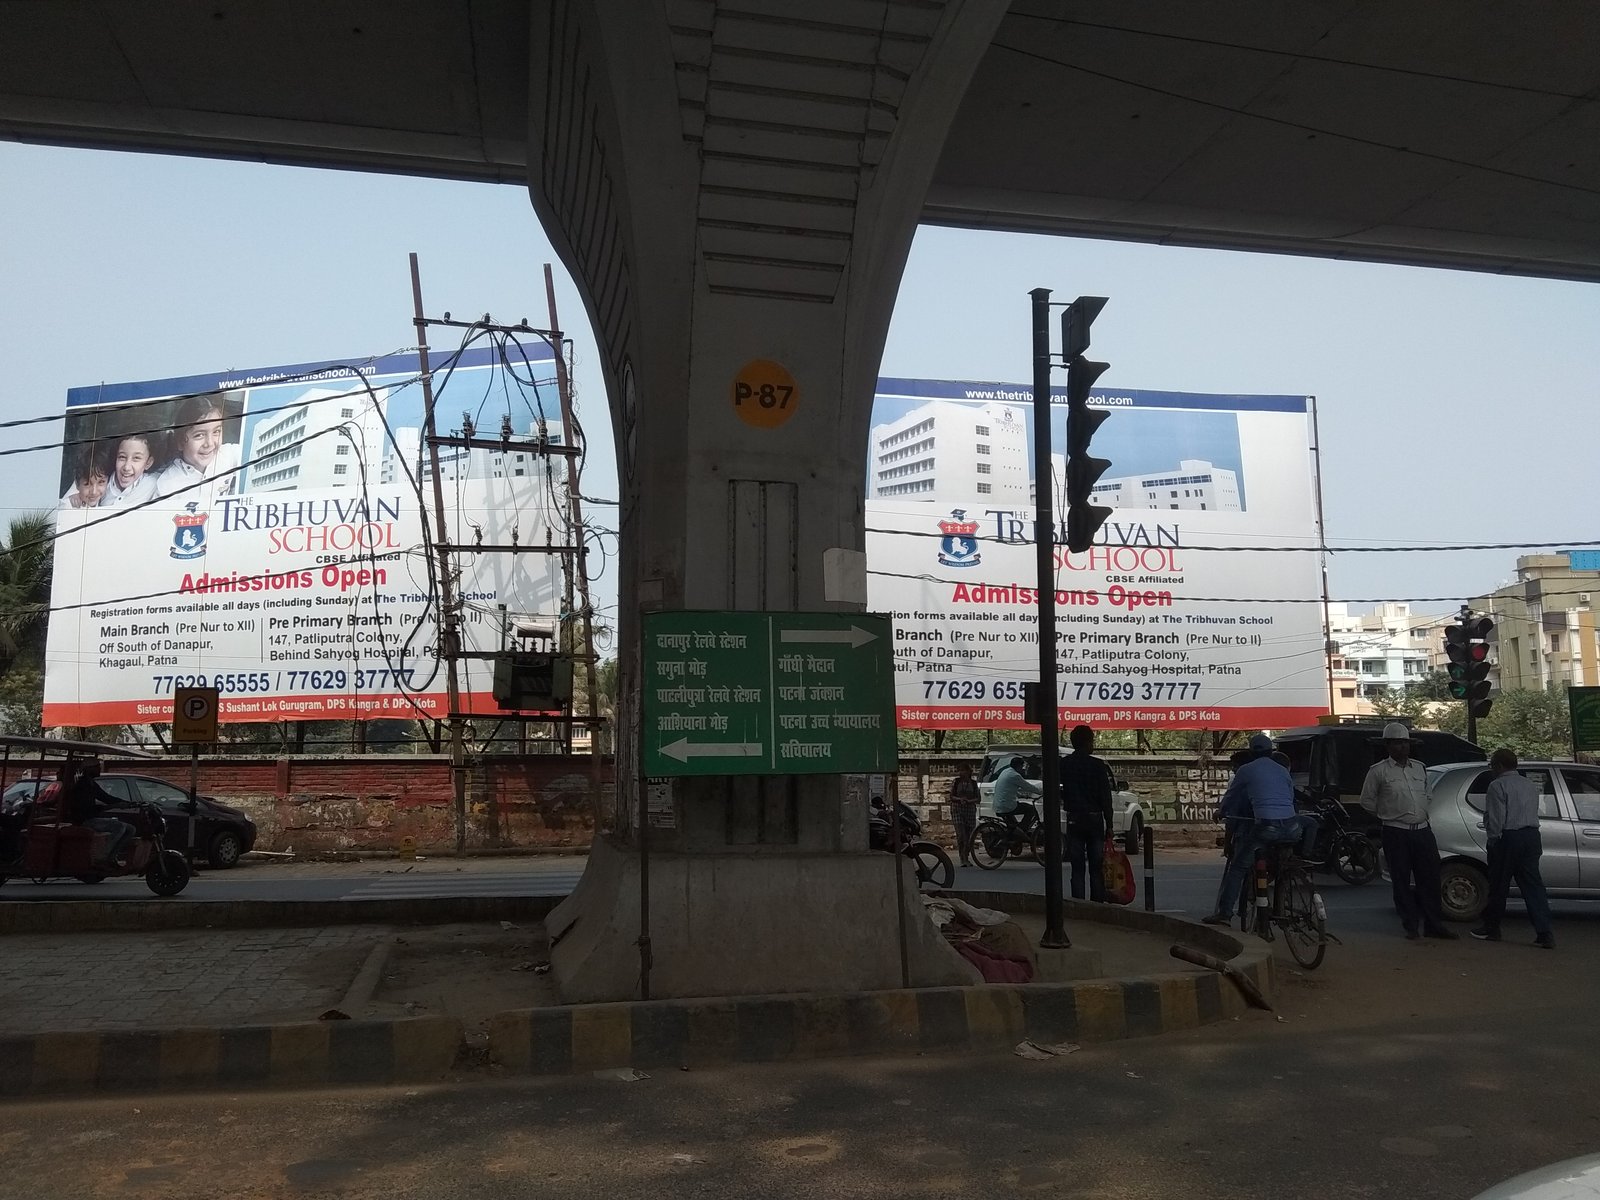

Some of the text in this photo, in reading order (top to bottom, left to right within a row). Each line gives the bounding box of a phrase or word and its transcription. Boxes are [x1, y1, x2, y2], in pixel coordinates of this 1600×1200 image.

[218, 365, 376, 389] wwwthetribhanschool.com
[736, 382, 794, 409] P-87
[965, 389, 1133, 406] www.thetribvanool.com
[214, 496, 401, 533] TRIBHUVAN
[268, 522, 401, 554] SCHOOL
[316, 554, 346, 564] CBSE
[1053, 544, 1184, 572] SCHOOL
[178, 564, 387, 595] Admissions Open
[1106, 575, 1184, 584] CBSE Affiliated
[90, 590, 497, 620] Registration forms available all days (including Sunday) at The Tribhu School
[952, 582, 1173, 611] Admisons Open
[269, 618, 290, 630] Pre
[292, 615, 342, 630] Primary
[346, 613, 392, 627] Branch
[470, 612, 482, 625] II)
[914, 611, 946, 620] forms
[949, 611, 1000, 622] available
[1002, 612, 1016, 622] all
[1018, 612, 1038, 624] day
[1054, 614, 1100, 625] ncluding
[1102, 614, 1146, 626] Sunday)
[1148, 615, 1160, 624] at
[1162, 615, 1182, 624] The
[1185, 615, 1236, 624] Tribhuvan
[1238, 616, 1274, 625] School
[100, 619, 256, 638] Main Branch (Pre Nur to XII)
[896, 629, 1040, 644] Branch (Pre Nur to XII)
[99, 639, 214, 654] Off South of Danapur,
[268, 630, 403, 647] 147, Patliputra Colony,
[656, 630, 748, 654] दानापुर रेलवे स्टेशन
[1054, 632, 1262, 647] Pre Primary Branch (Pre Nur to II)
[99, 654, 178, 670] Khagaul, Patna
[270, 649, 311, 662] Behind
[314, 648, 360, 662] Sahyog
[364, 646, 419, 660] Hospital,
[892, 646, 994, 660] uth of Danapur,
[1054, 649, 1190, 662] 147, Patliputra Colony,
[656, 657, 708, 680] सगुना मोड़
[806, 654, 836, 673] मैदान
[916, 662, 953, 673] Patna
[1056, 663, 1242, 677] Behind Sahyog Hospital, Patna
[152, 668, 416, 695] 77629 65555 / 77629 37777
[922, 680, 1202, 701] 77629 655 / 77629 37777
[706, 684, 732, 703] रेलवे
[733, 684, 762, 703] स्टेशन
[778, 682, 845, 702] पटना जंक्शन
[136, 704, 160, 714] Sister
[226, 702, 260, 714] Sushant
[262, 701, 278, 712] Lok
[279, 700, 326, 713] Gurugram,
[327, 700, 346, 710] DPS
[348, 698, 381, 711] Kangra
[382, 698, 390, 709] &
[392, 698, 411, 709] DPS
[414, 698, 436, 708] Kota
[190, 700, 204, 716] P
[657, 712, 729, 734] आशियाना मोड़
[779, 714, 808, 730] पटना
[832, 714, 881, 729] न्यायालय
[901, 710, 929, 720] Sister
[932, 712, 970, 720] concern
[972, 710, 982, 720] of
[984, 710, 1003, 720] DPS
[1064, 711, 1112, 722] Gurugram,
[1113, 710, 1132, 721] DPS
[1134, 711, 1167, 722] Kangra
[1169, 711, 1176, 721] &
[1178, 711, 1198, 721] DPS
[1199, 711, 1221, 721] Kota
[780, 738, 832, 758] सचिवालय
